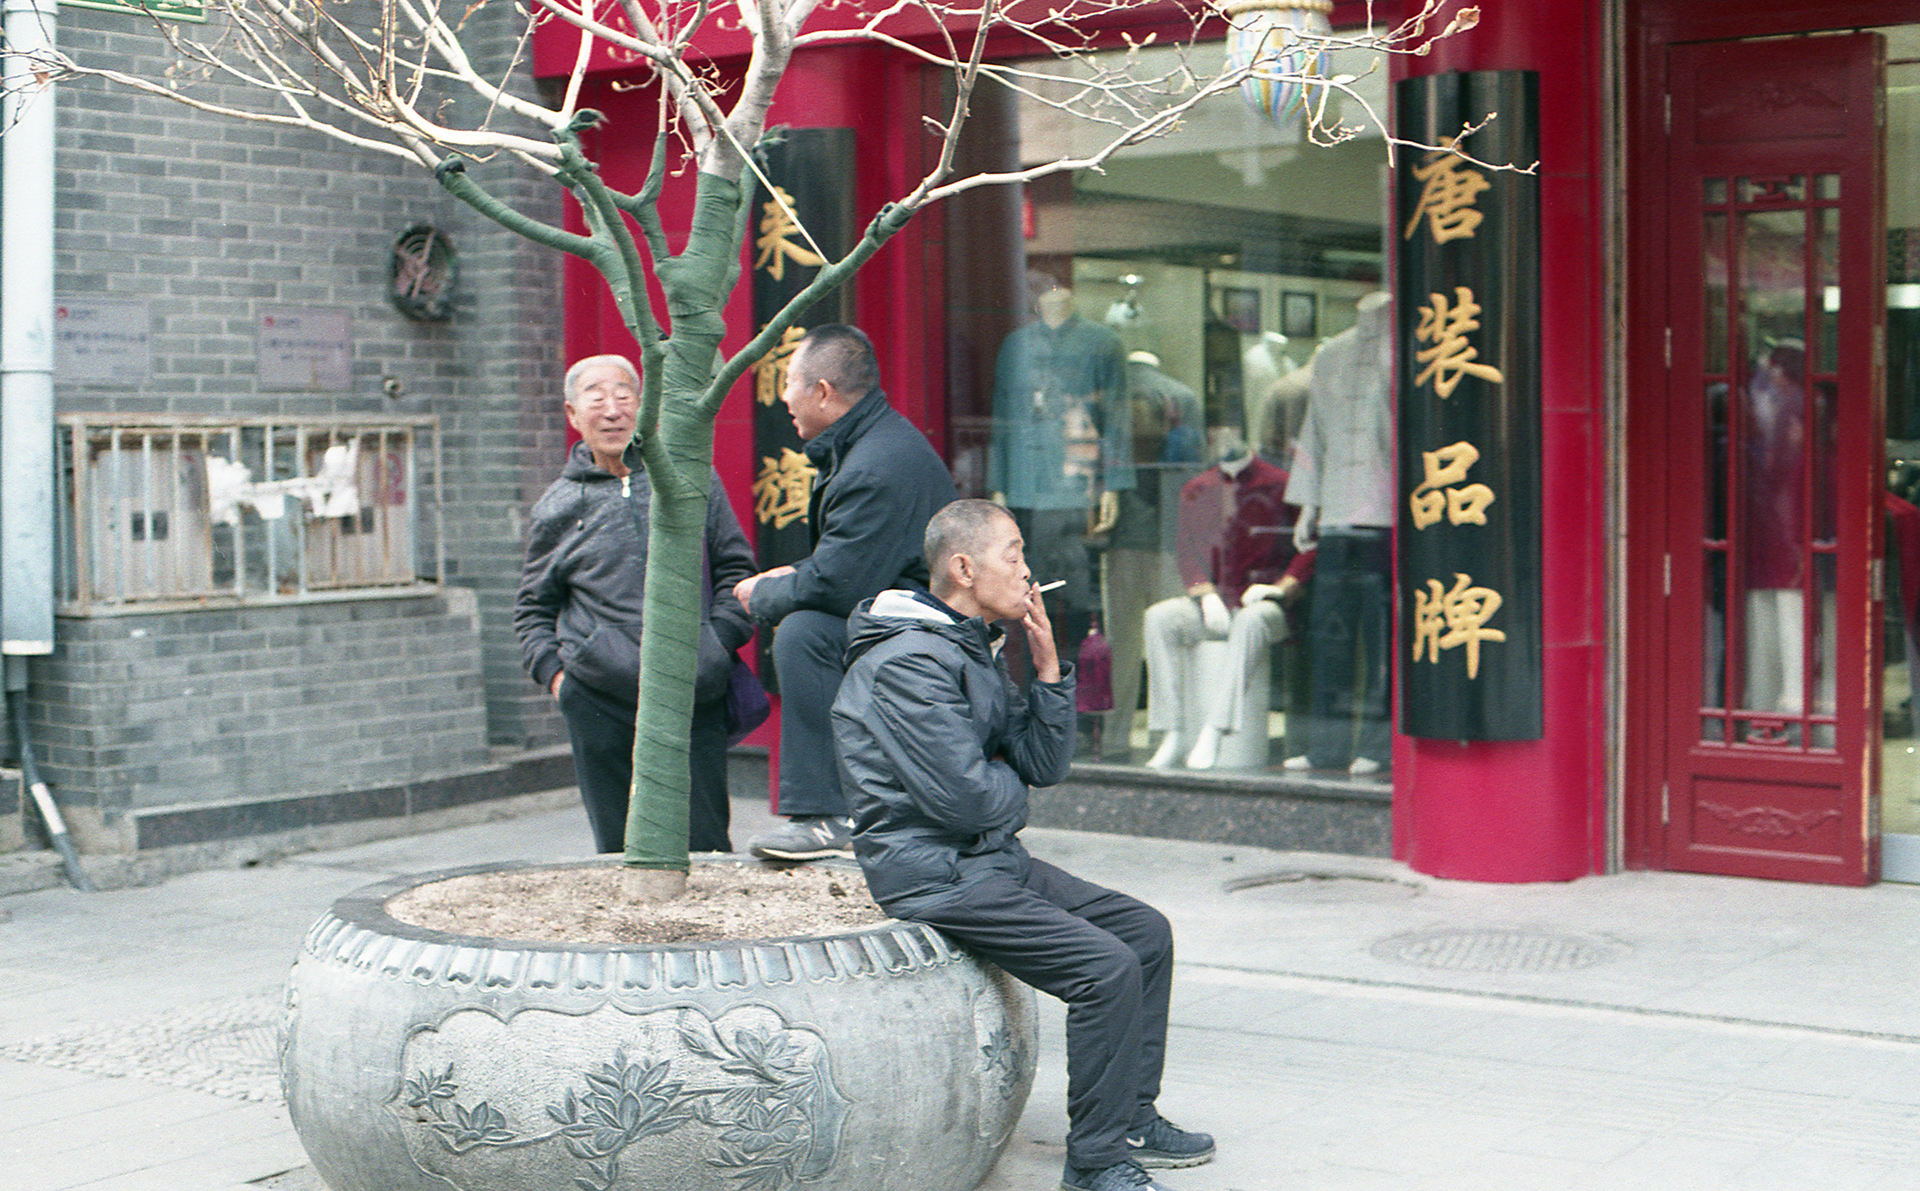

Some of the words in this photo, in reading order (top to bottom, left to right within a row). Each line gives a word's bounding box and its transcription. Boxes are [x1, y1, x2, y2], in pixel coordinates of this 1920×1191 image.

[1404, 136, 1506, 680] 唐装品牌
[812, 821, 835, 845] N
